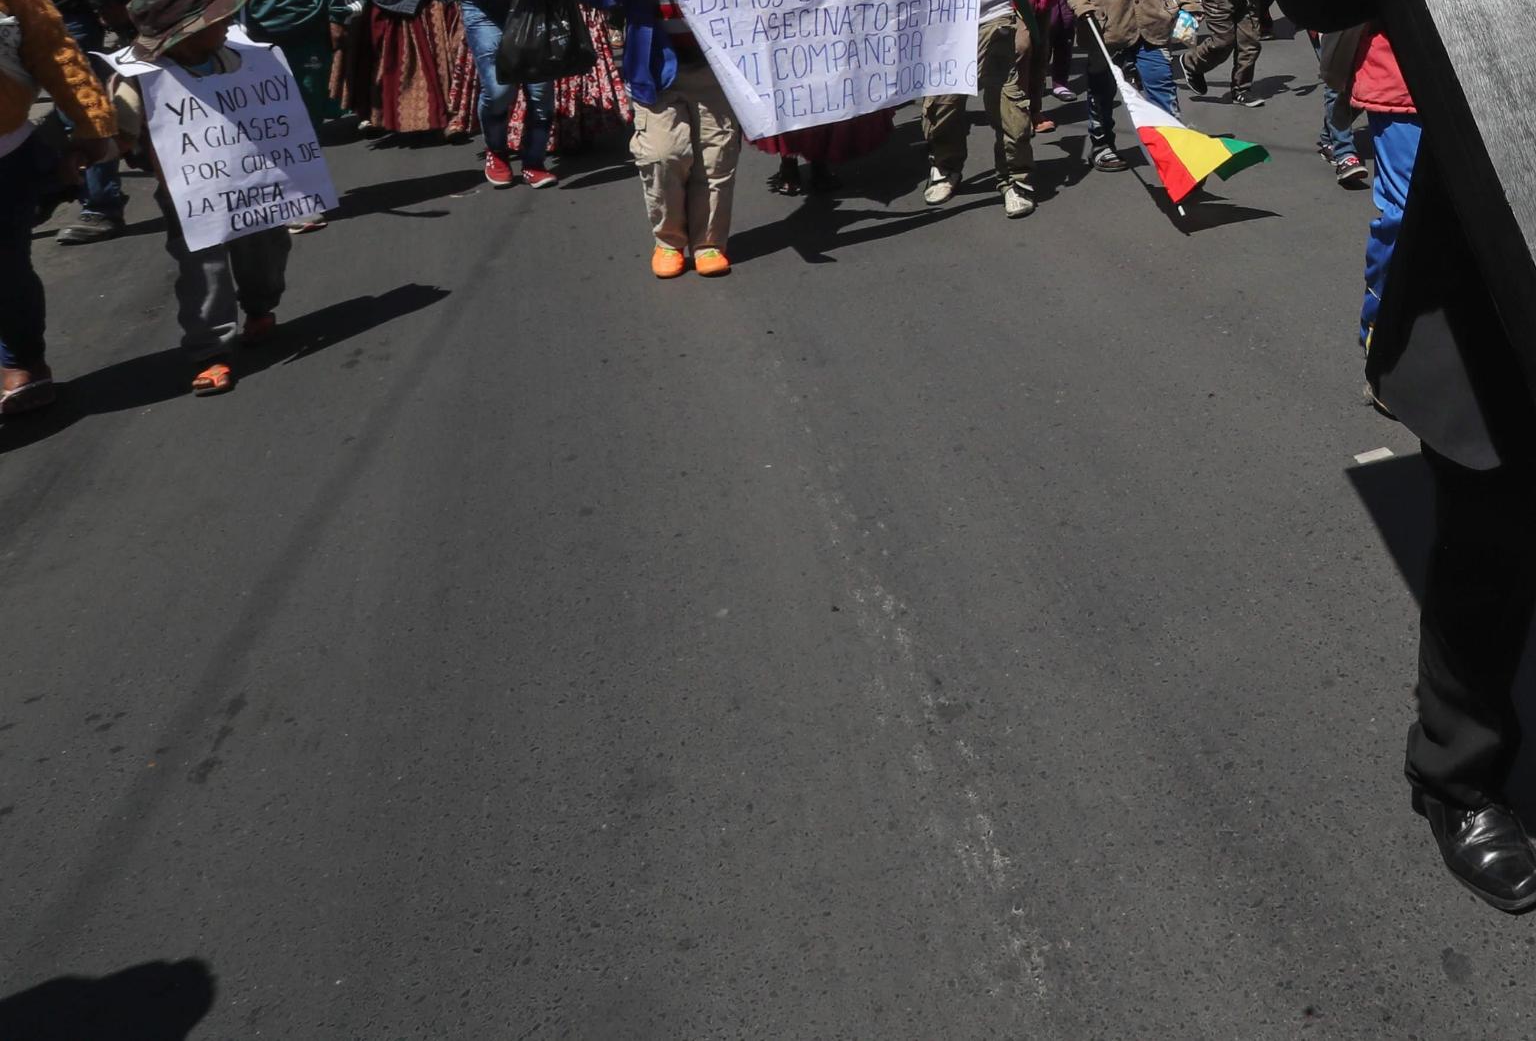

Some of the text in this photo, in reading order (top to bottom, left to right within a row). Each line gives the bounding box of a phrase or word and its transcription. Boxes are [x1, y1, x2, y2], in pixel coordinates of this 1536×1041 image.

[709, 17, 744, 49] EL
[752, 2, 889, 44] ASECINATO
[895, 0, 921, 32] DE
[773, 31, 923, 81] COMPAÑERA
[165, 74, 290, 125] YA NO VOY
[867, 59, 958, 102] CHOQUE
[181, 132, 200, 155] A
[181, 141, 322, 187] POR CULPA DE
[187, 182, 285, 218] LA TAREA
